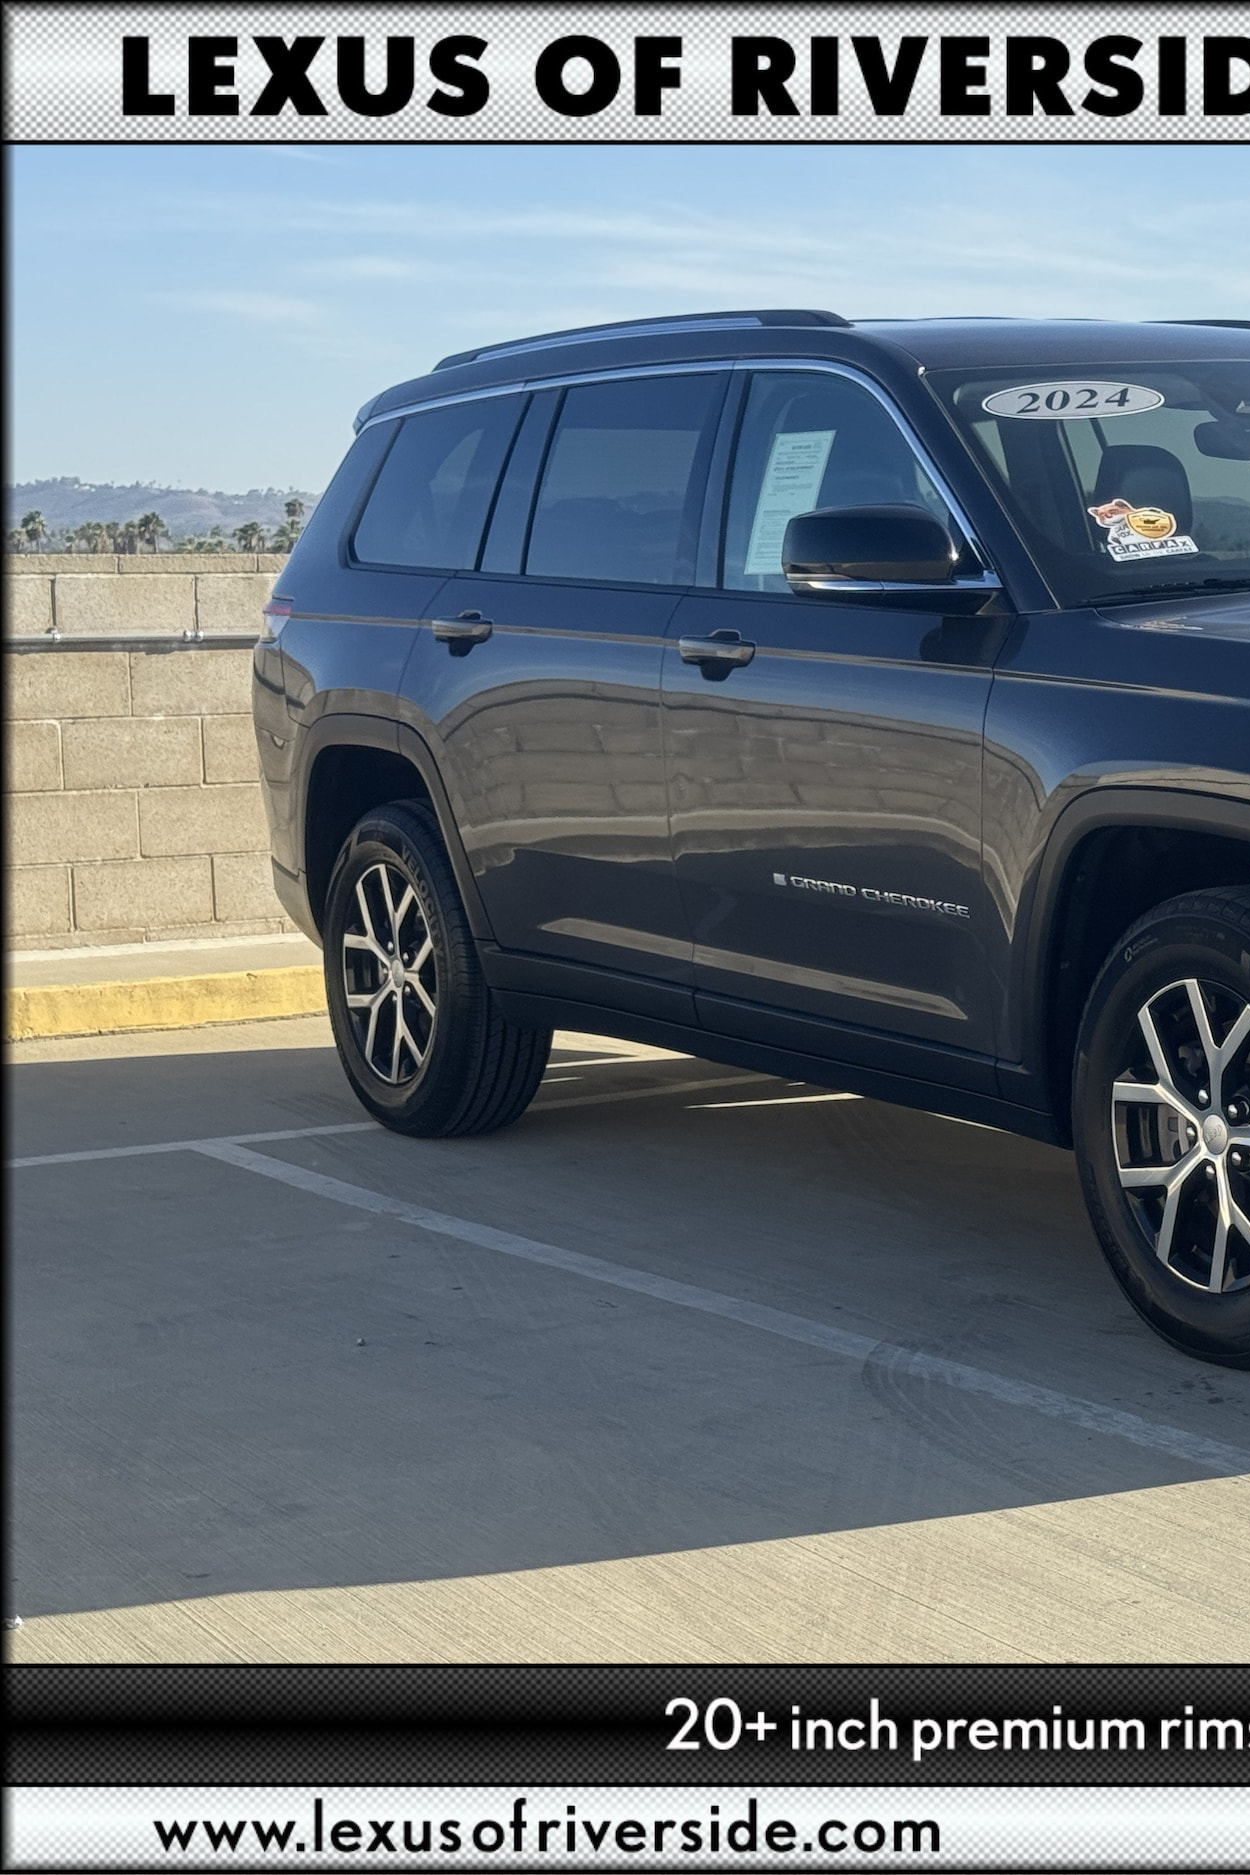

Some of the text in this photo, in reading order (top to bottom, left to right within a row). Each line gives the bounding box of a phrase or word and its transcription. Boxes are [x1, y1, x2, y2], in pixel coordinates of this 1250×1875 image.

[1016, 387, 1131, 414] 2024
[1112, 539, 1191, 554] CARFAX
[789, 875, 971, 919] GRAND CHEROKEE
